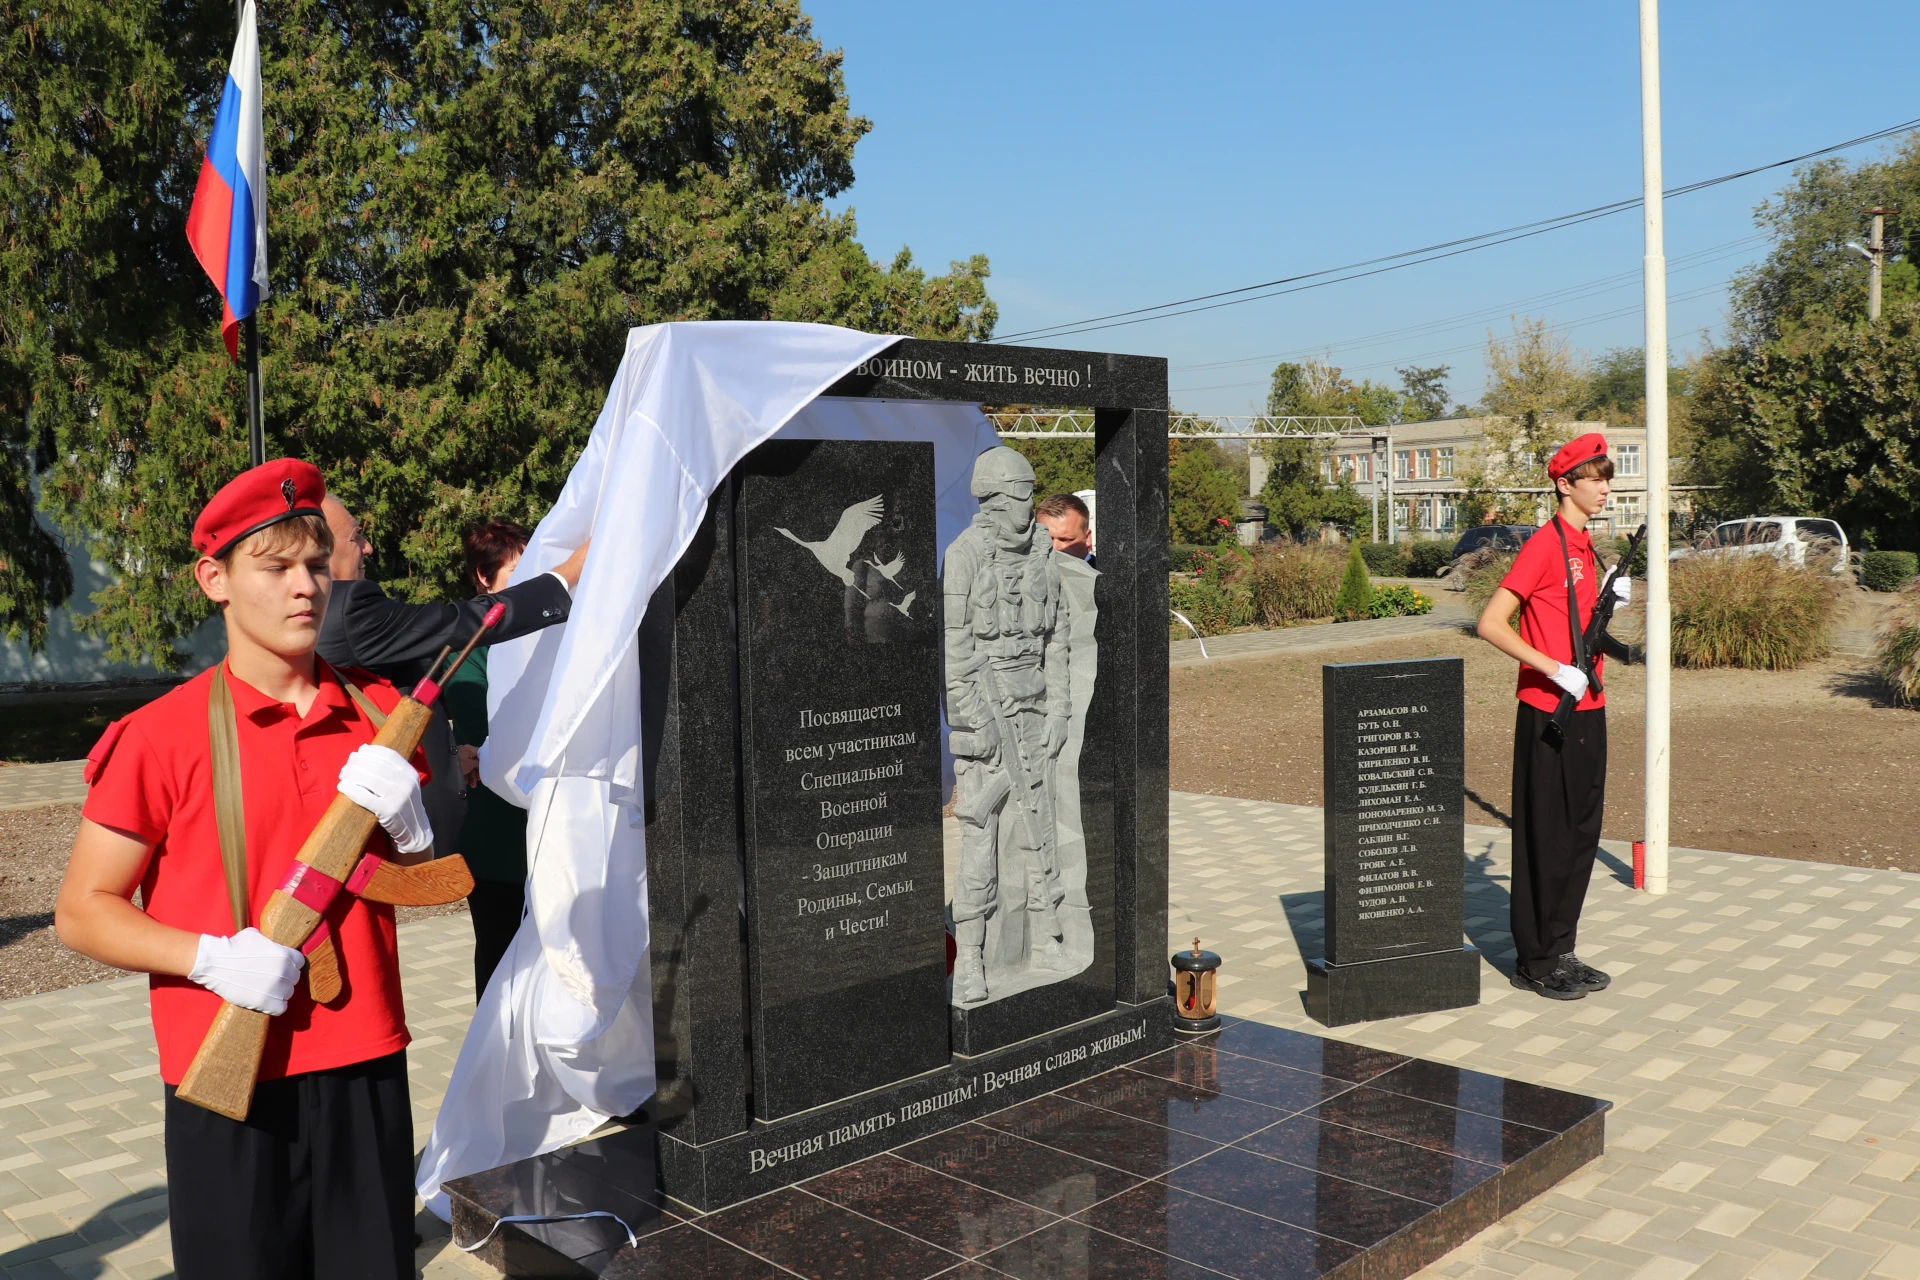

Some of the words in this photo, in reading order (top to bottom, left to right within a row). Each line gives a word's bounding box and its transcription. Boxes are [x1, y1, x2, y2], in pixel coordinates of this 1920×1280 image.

[965, 363, 1017, 384] жить
[1023, 367, 1080, 388] вечно
[800, 703, 902, 729] Посвящается
[1358, 707, 1408, 717] АРЗАМАСОВ
[1358, 722, 1379, 730] БУТЬ
[1358, 733, 1401, 743] ГРИГОРОВ
[785, 745, 823, 762] всем
[828, 731, 916, 761] участникам
[1358, 746, 1397, 755] КАЗОРИН
[1358, 757, 1410, 768] КИРИЛЕНКО
[800, 760, 903, 791] Специальной
[1358, 768, 1415, 781] КОВАЛЬСКИЙ
[1358, 783, 1409, 794] КУДЕЛЬКИН
[820, 792, 888, 819] Военной
[1358, 796, 1401, 806] ЛИХОМАН
[1358, 807, 1424, 819] ПОНОМАРЕНКО
[1358, 819, 1420, 832] ПРИХОДЧЕНКО
[816, 824, 893, 850] Операции
[1359, 835, 1393, 844] САБЛИН
[1359, 847, 1398, 857] СОБОЛЕВ
[812, 851, 907, 883] Защитникам
[1359, 860, 1386, 870] ТРОЯК
[1359, 872, 1399, 882] ФИЛАТОВ
[1359, 882, 1414, 895] ФИЛИМОНОВ
[797, 890, 862, 916] Родины,
[866, 878, 914, 901] Семьи
[1359, 898, 1386, 907] ЧУДОВ
[1359, 908, 1404, 920] ЯКОВЕНКО
[825, 926, 834, 941] и
[839, 910, 890, 937] Чести!
[749, 1133, 823, 1174] Вечная
[829, 1111, 896, 1148] память
[900, 1076, 978, 1123] павшим!
[983, 1060, 1042, 1094] Вечная
[1045, 1044, 1087, 1072] слава
[1090, 1018, 1147, 1057] живым!
